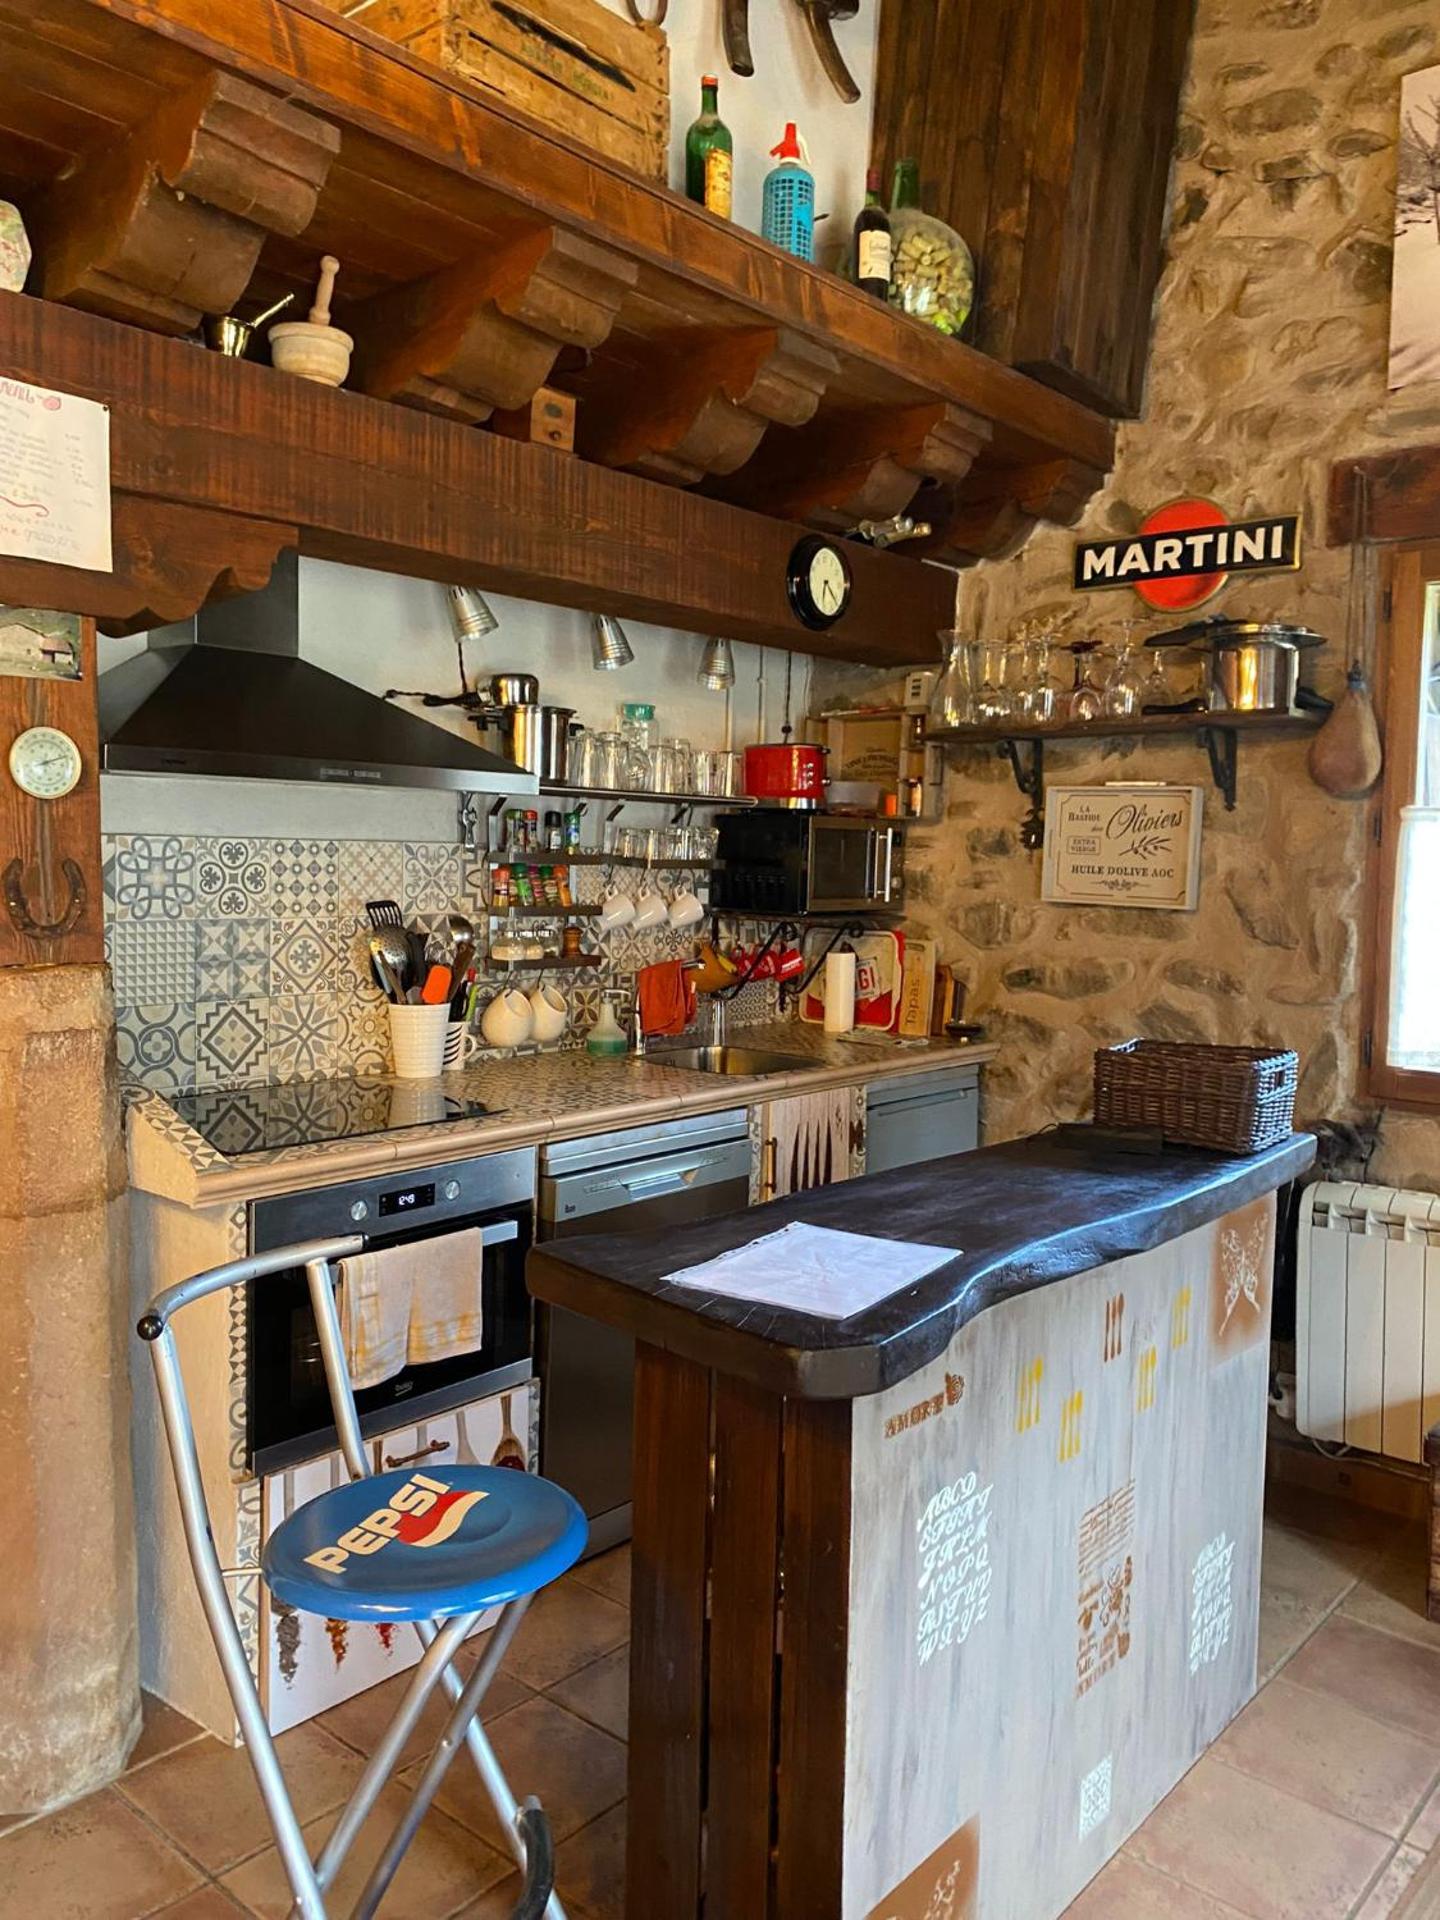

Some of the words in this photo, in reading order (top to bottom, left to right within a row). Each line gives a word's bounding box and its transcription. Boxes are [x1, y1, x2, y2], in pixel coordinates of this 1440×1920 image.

[1083, 525, 1284, 581] MARTINI
[1080, 804, 1091, 813] LA
[1105, 803, 1184, 840] Oliviers
[1071, 864, 1105, 875] HUILE
[1151, 868, 1175, 878] AOC
[905, 978, 920, 1026] Tapas
[303, 1473, 451, 1575] PEPSI
